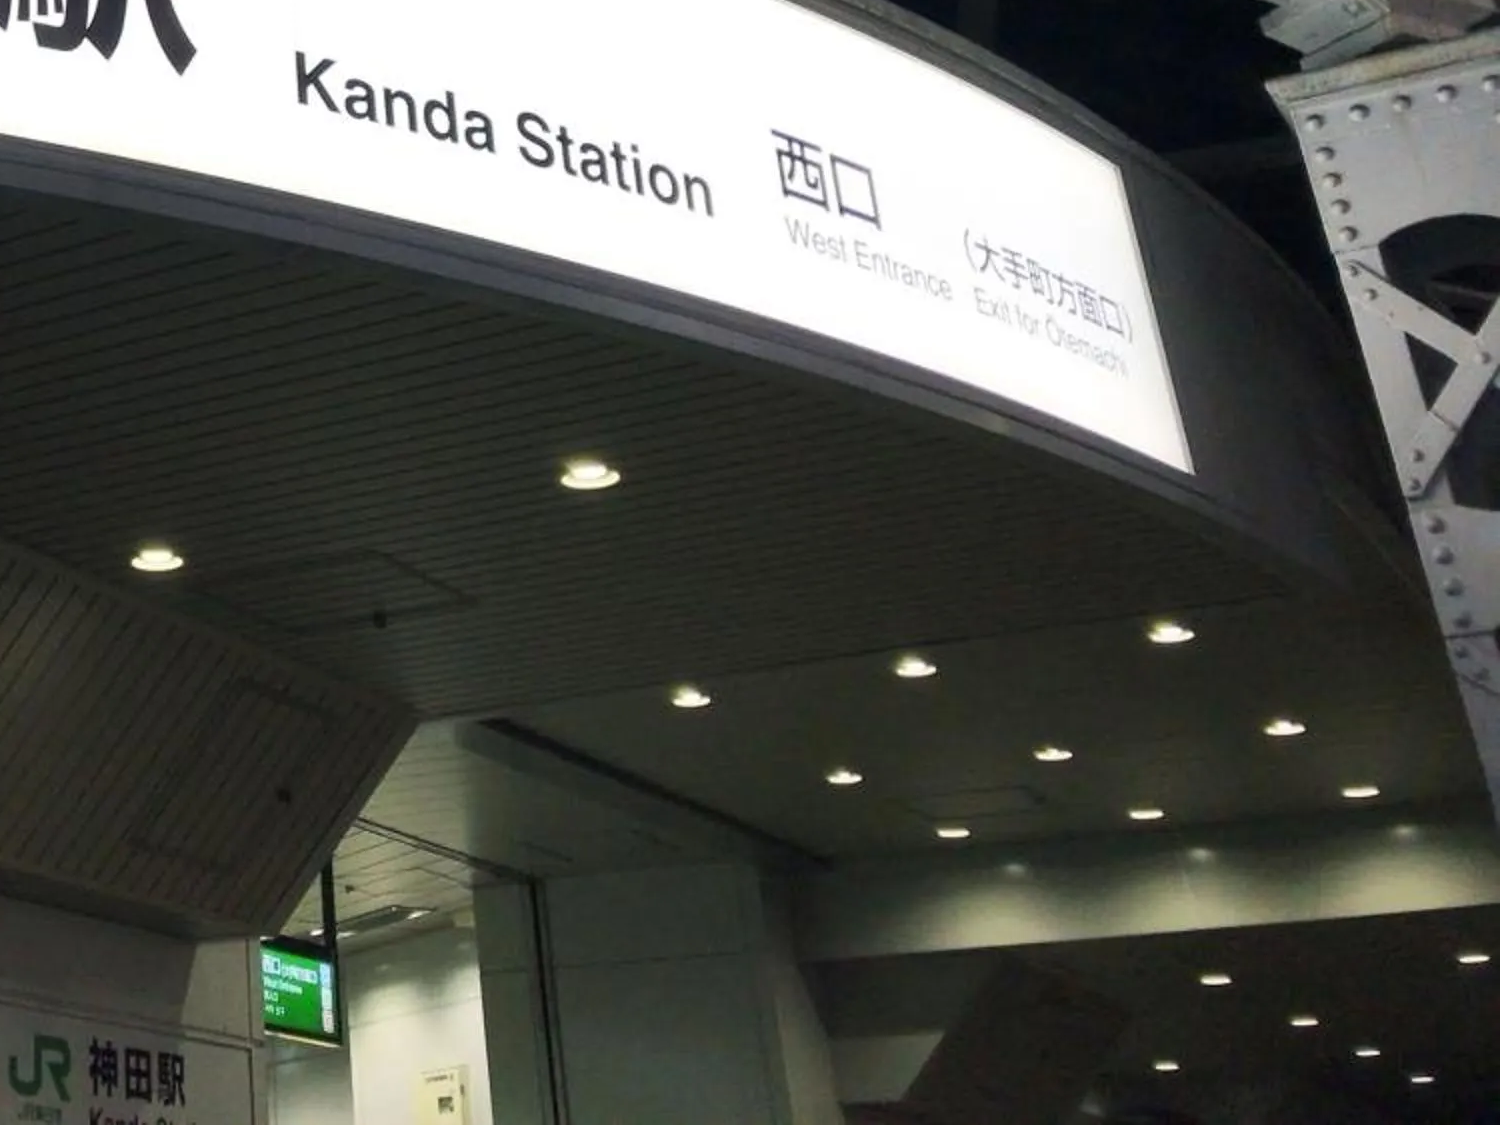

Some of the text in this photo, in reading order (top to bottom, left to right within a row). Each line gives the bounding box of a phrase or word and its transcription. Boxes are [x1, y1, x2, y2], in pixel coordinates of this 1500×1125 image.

[295, 51, 715, 218] Kanda Station
[770, 128, 883, 231] 西口
[784, 216, 954, 302] West Entrance
[973, 286, 1013, 327] Exit
[1016, 306, 1041, 337] for
[8, 1033, 71, 1102] JR
[89, 1035, 186, 1108] 神田駅
